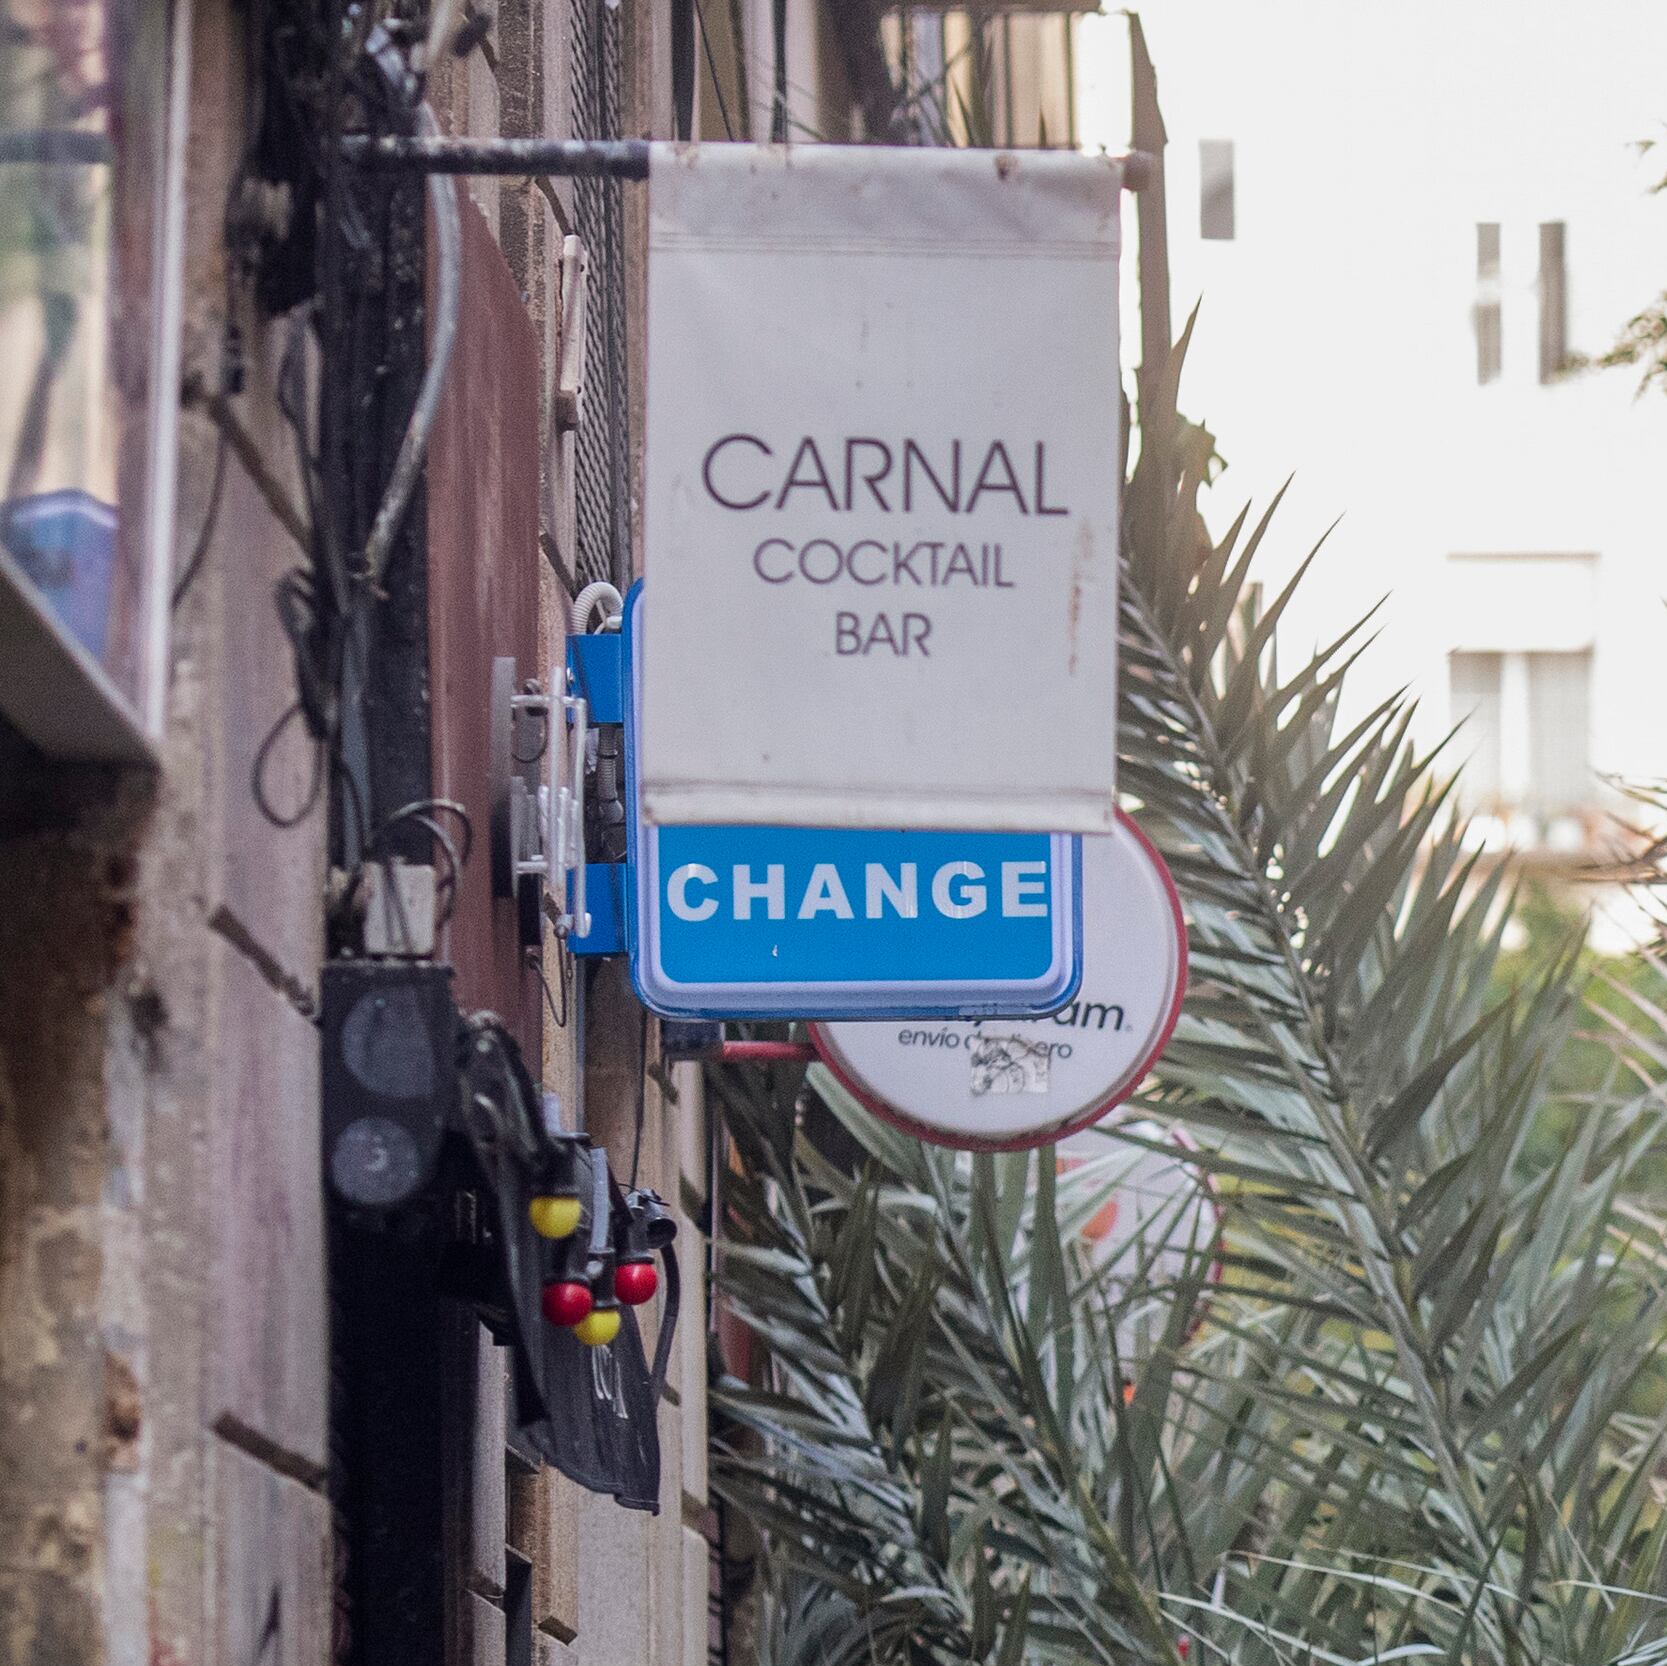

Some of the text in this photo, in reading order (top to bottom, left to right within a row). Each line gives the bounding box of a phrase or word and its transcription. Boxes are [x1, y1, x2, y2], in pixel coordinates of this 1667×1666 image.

[701, 433, 1069, 517] CARNAL
[753, 537, 1015, 590] COCKTAIL
[834, 612, 932, 658] BAR
[666, 859, 1049, 921] CHANGE
[898, 1026, 961, 1050] envío
